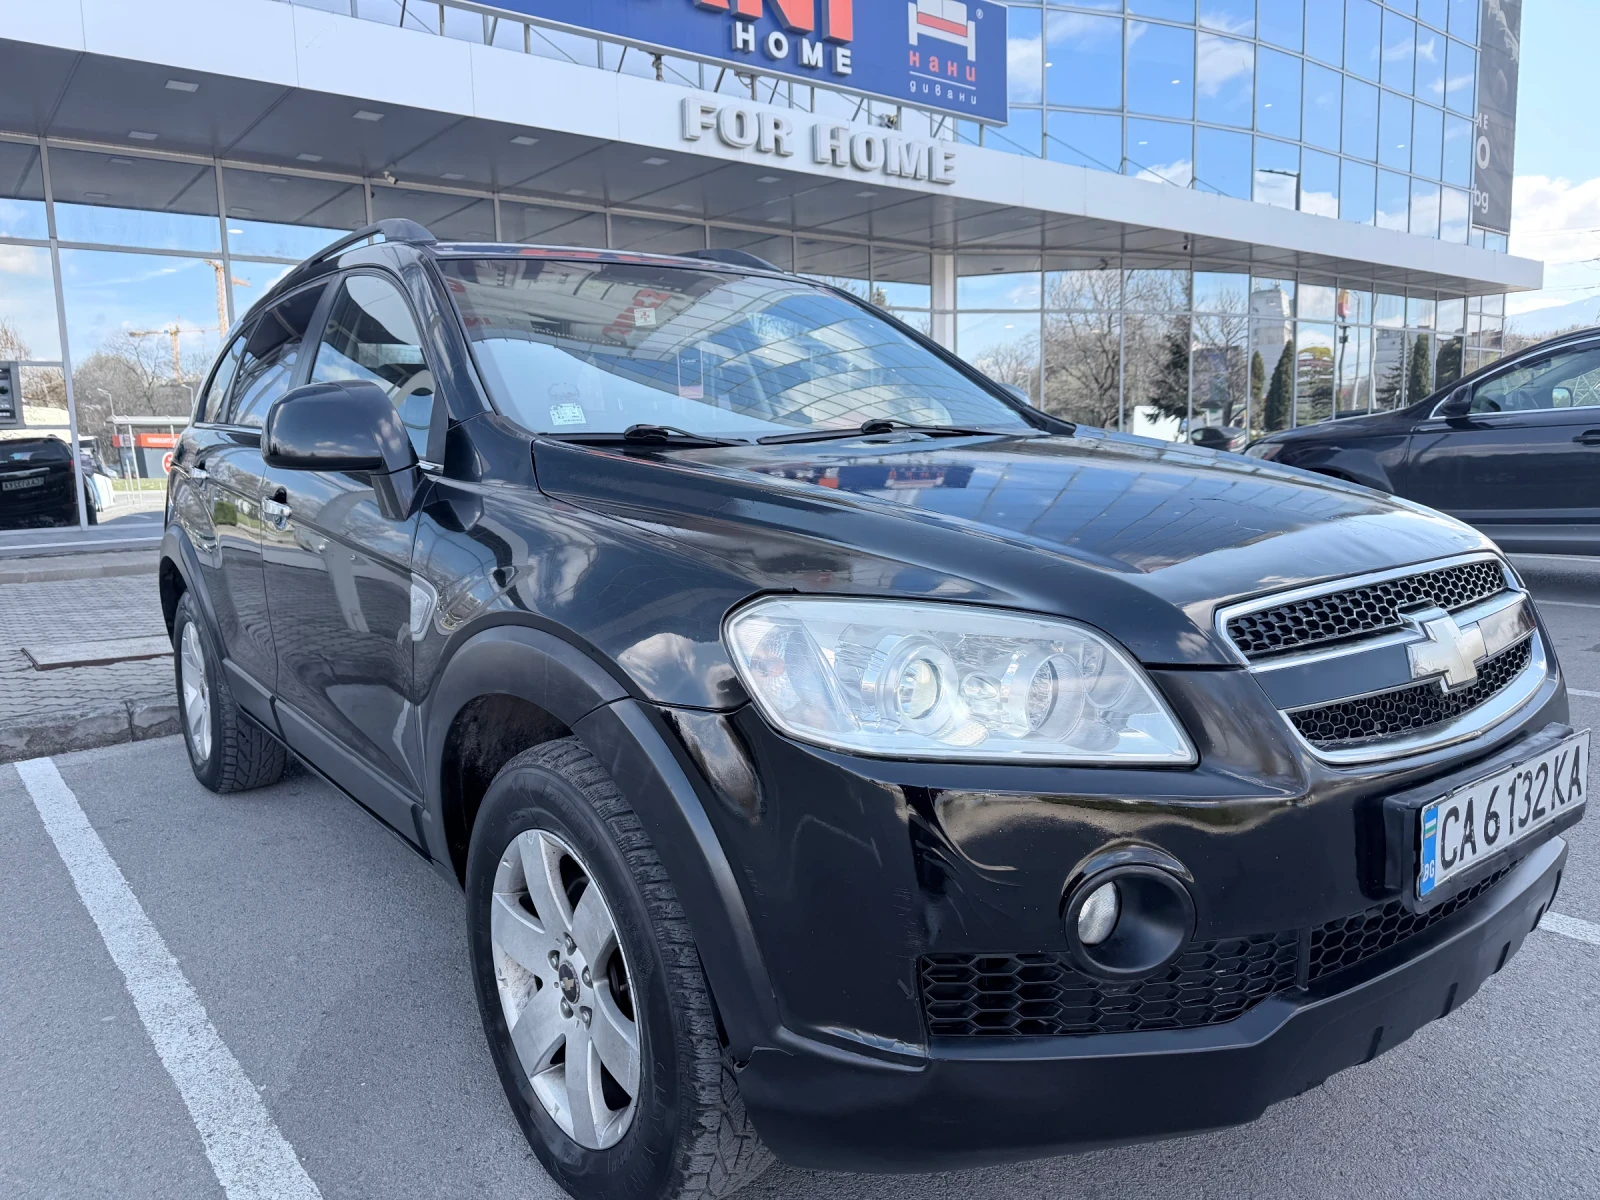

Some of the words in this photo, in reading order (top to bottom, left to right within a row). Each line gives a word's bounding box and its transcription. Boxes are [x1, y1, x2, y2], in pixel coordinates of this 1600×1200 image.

[733, 21, 852, 75] HOME
[682, 97, 793, 157] FOR
[812, 123, 956, 184] HOME
[1423, 860, 1435, 883] BG
